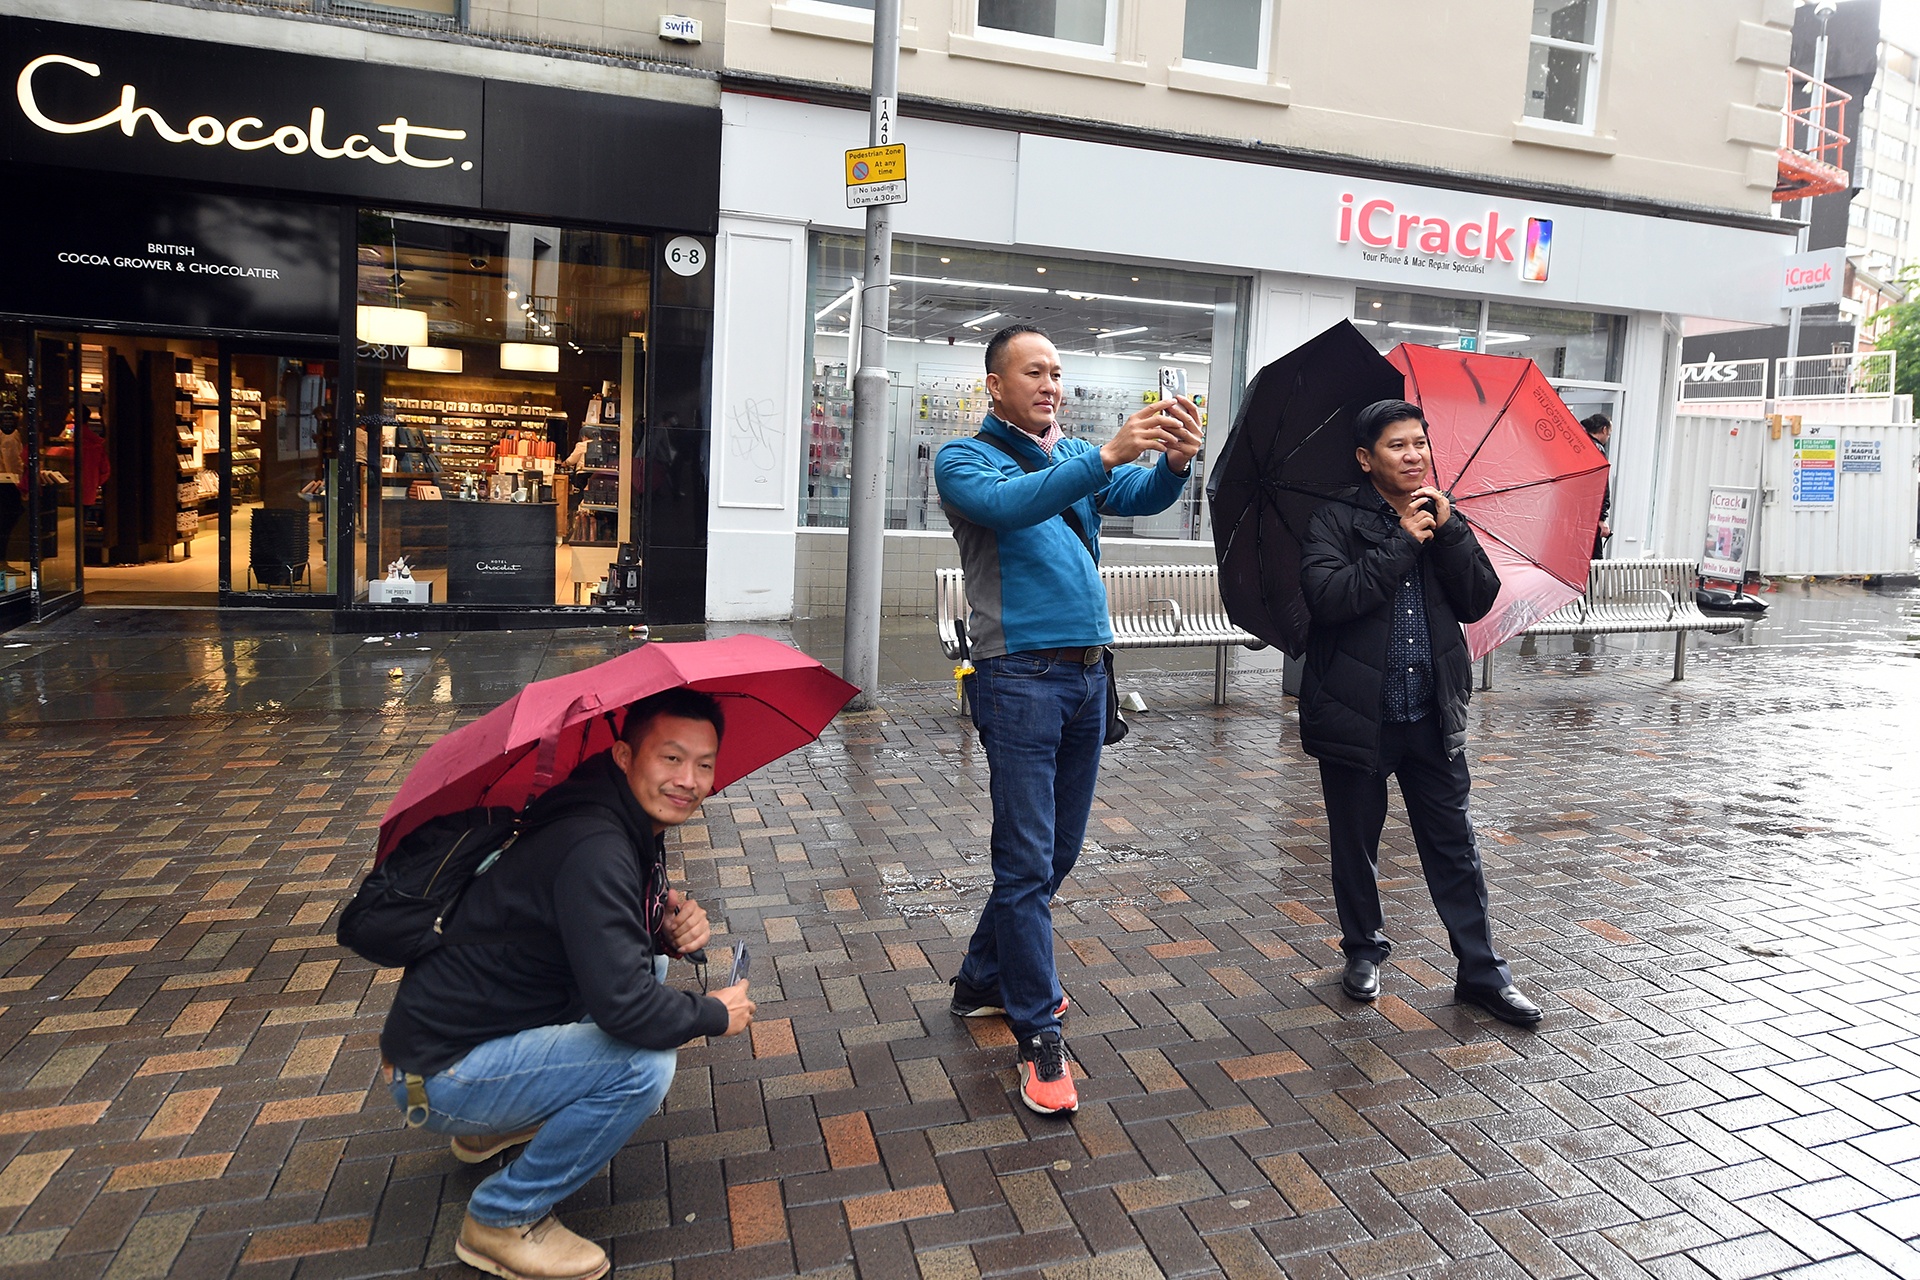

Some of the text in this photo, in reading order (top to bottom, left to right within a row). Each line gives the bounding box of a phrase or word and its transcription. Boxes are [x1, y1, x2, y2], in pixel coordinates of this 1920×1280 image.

[665, 21, 694, 35] swift
[849, 148, 901, 160] Pedestrian Zone
[884, 160, 896, 168] any
[870, 184, 895, 193] loading
[1338, 193, 1516, 263] iCrack
[147, 243, 195, 256] BRITISH
[671, 247, 699, 265] 6-8
[57, 252, 280, 280] COCOA GROWER & CHOCOLATIER
[1362, 251, 1485, 274] Your Phone & Mac Repair Specialist
[1785, 262, 1831, 286] iCrack
[1712, 494, 1741, 508] iCrack
[1717, 514, 1731, 524] Repair
[1731, 515, 1747, 525] Phones
[1703, 562, 1741, 576] While You Wait
